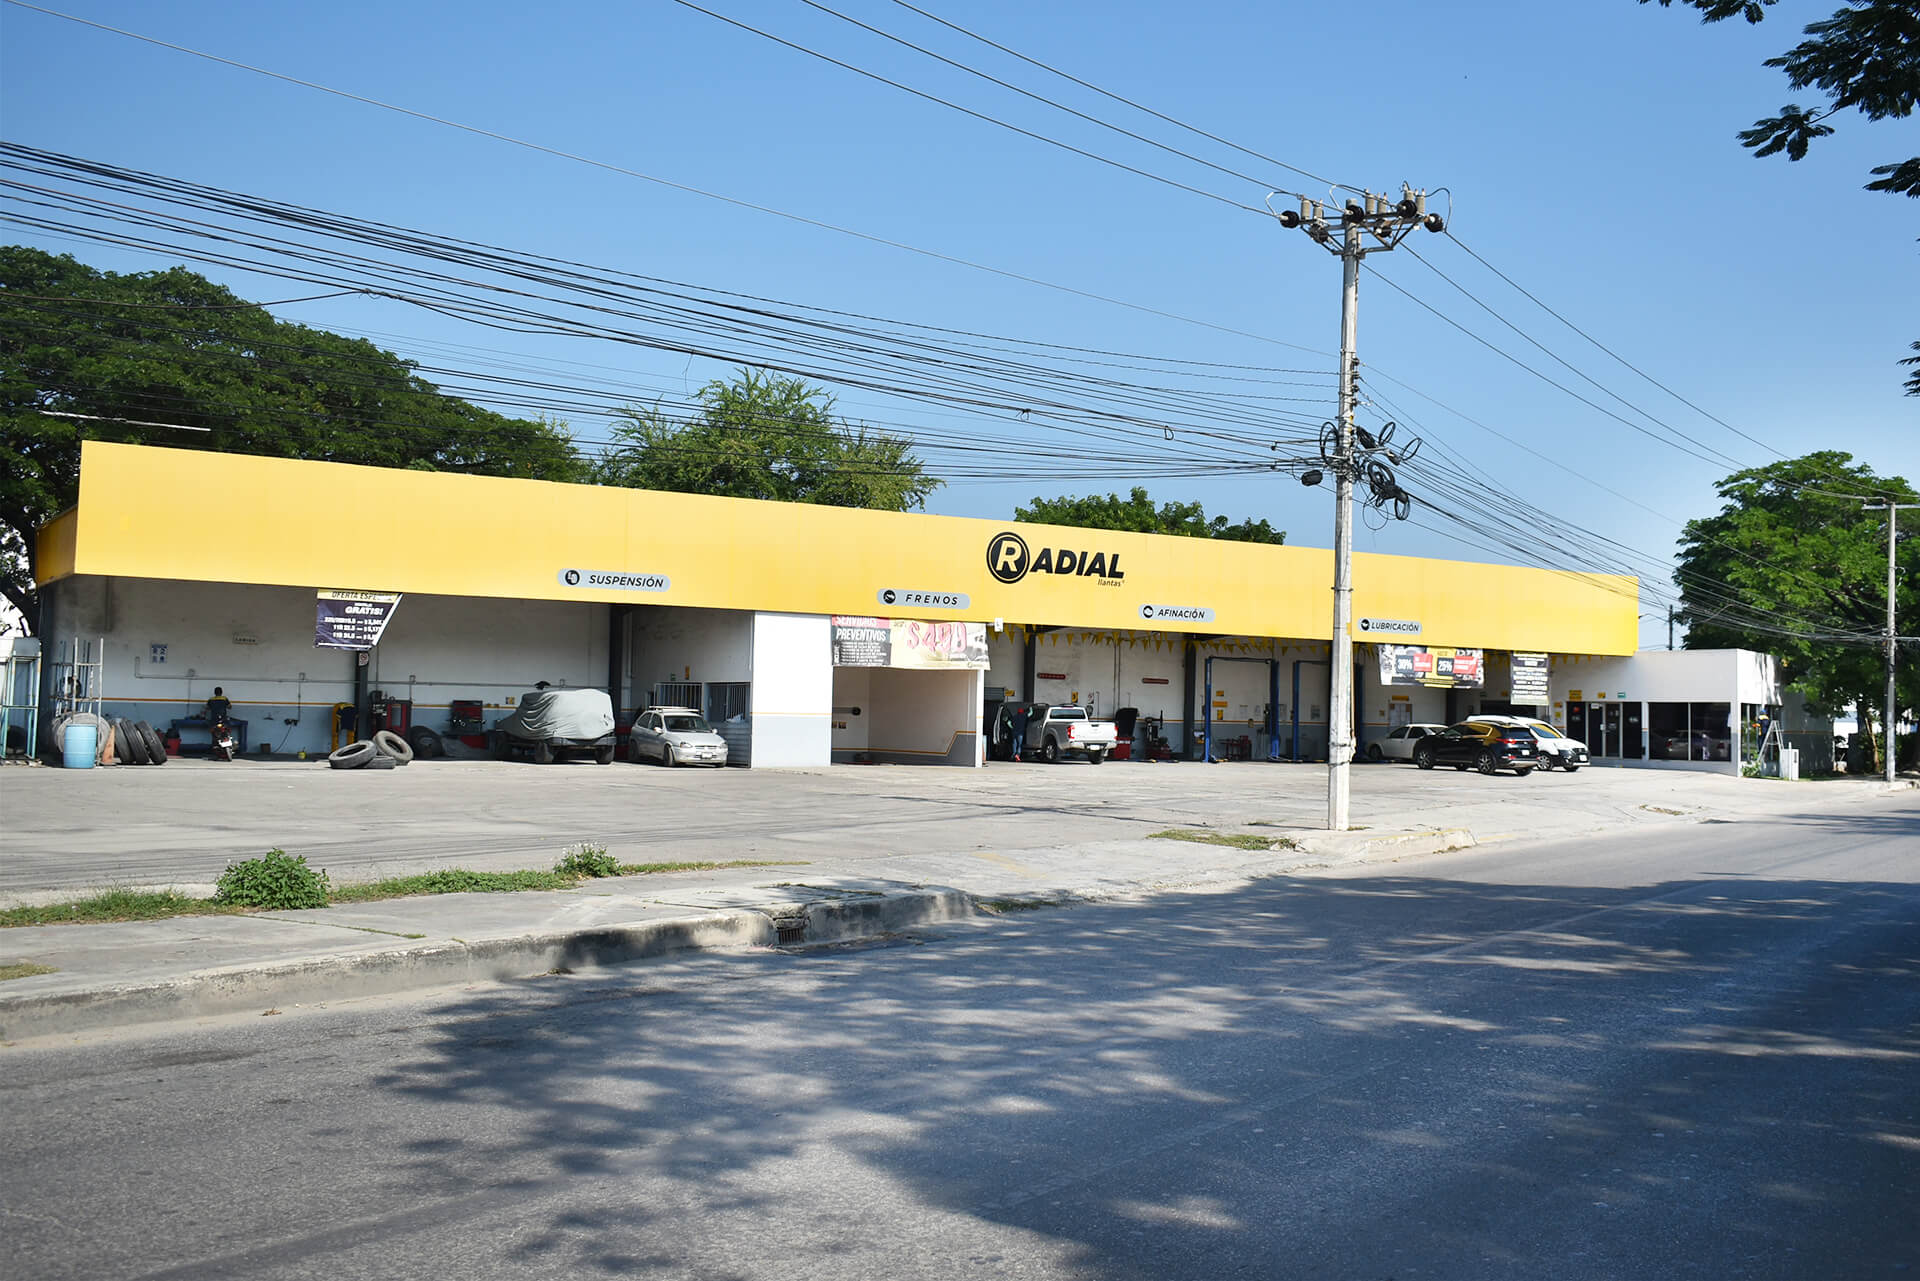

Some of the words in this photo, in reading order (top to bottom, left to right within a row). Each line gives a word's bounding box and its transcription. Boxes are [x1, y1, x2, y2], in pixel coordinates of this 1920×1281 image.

[987, 532, 1125, 583] RADIAL
[589, 575, 664, 588] SUSPENSIÓN
[1098, 579, 1121, 587] llantas
[905, 594, 958, 605] FRENOS
[345, 606, 384, 616] GRATIS!
[1158, 608, 1205, 619] AFINACIÓN
[1371, 622, 1419, 632] LUBRICACIÓN
[836, 628, 887, 642] PREVENTIVOS
